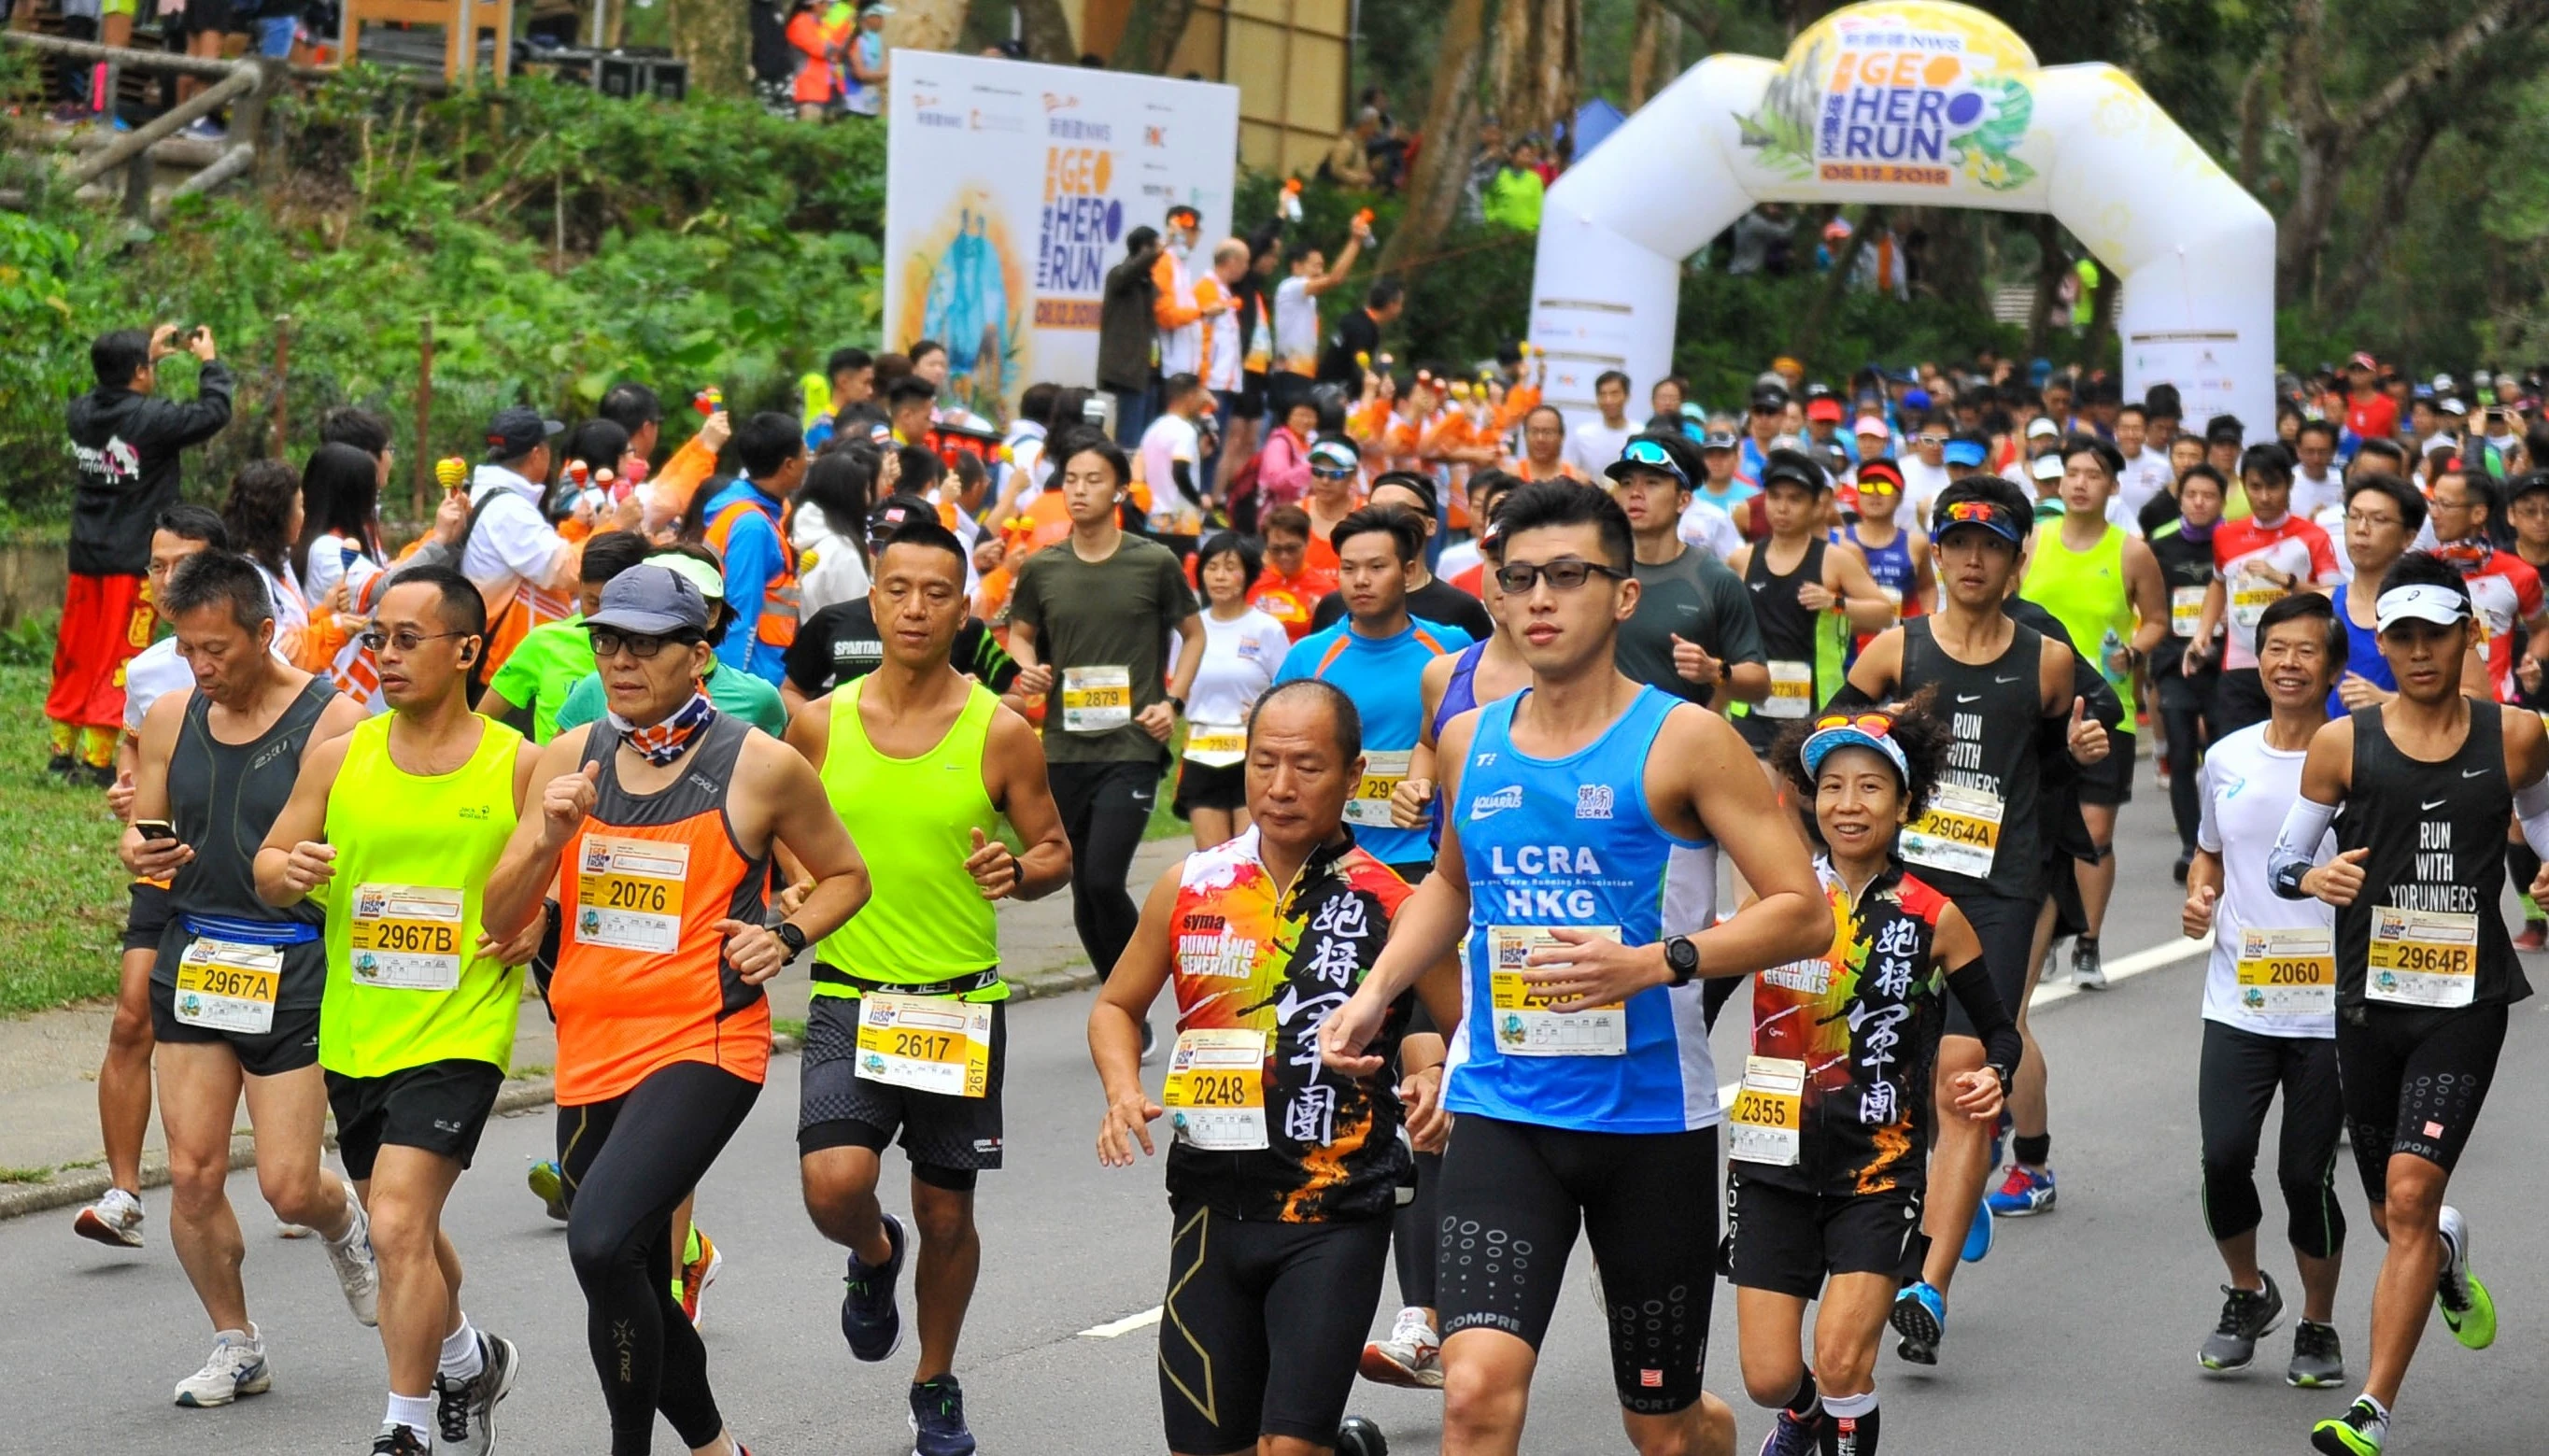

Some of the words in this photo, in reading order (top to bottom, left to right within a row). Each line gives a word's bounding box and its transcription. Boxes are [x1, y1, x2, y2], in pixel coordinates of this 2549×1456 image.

[1850, 87, 1984, 125] HERO
[1845, 126, 1943, 161] RUN
[1055, 196, 1123, 243] HERO
[1050, 244, 1103, 290] RUN
[1085, 691, 1119, 707] 2879
[1952, 713, 1982, 741] RUN
[1577, 808, 1611, 818] LCRA
[1928, 814, 1990, 846] 2964A
[2420, 822, 2451, 850] RUN
[1493, 845, 1601, 875] LCRA
[2415, 854, 2454, 882] WITH
[609, 880, 666, 911] 2076
[1506, 889, 1595, 918] HKG
[2388, 884, 2478, 912] YORUNNERS
[1183, 914, 1225, 931] syma
[377, 924, 452, 952] 2967B
[1181, 954, 1252, 979] GENERALS
[2270, 962, 2320, 983] 2060
[2397, 945, 2468, 972] 2964B
[203, 968, 269, 1000] 2967A
[1763, 969, 1828, 995] GENERALS
[895, 1033, 951, 1060] 2617
[970, 1058, 984, 1094] 2617
[1193, 1076, 1245, 1105] 2248
[1741, 1096, 1785, 1124] 2355
[1445, 1312, 1521, 1333] COMPRE
